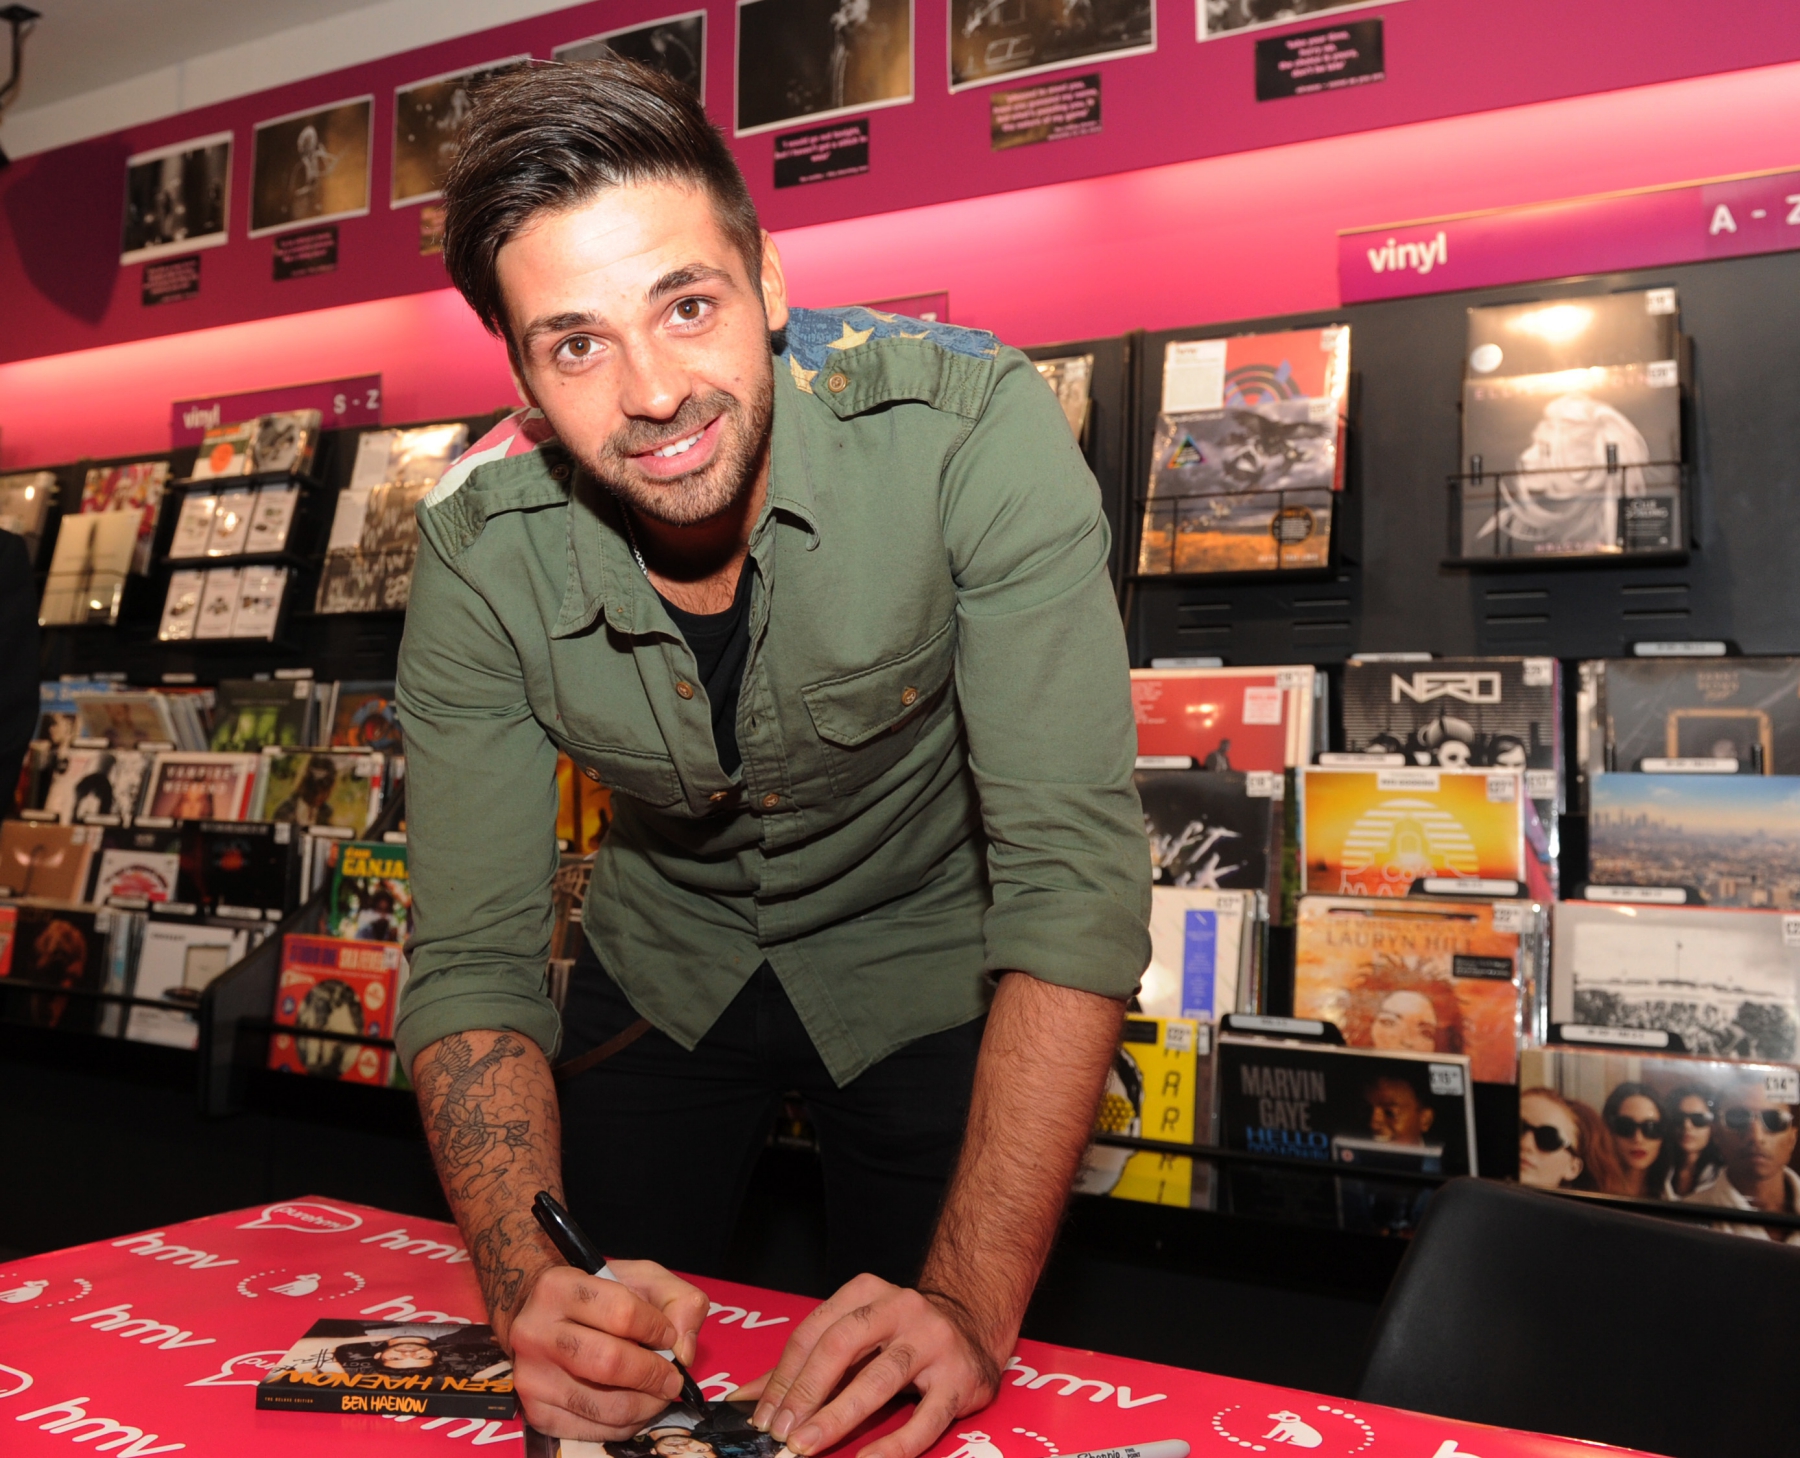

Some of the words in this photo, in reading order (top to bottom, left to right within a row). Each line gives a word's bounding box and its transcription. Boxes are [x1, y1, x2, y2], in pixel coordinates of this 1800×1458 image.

[1709, 204, 1737, 235] A
[1367, 231, 1447, 275] vinyl
[182, 404, 220, 430] vinyl
[333, 392, 346, 414] S
[366, 388, 379, 410] Z
[1326, 930, 1416, 950] LAURYN
[1425, 935, 1471, 952] HILL
[1240, 1064, 1327, 1103] MARVIN
[1259, 1098, 1312, 1131] GAYE
[273, 1206, 348, 1230] purehmv
[111, 1231, 239, 1270] hmv
[70, 1303, 216, 1350] hmv
[1004, 1356, 1167, 1409] hmv
[341, 1395, 368, 1412] BEN
[370, 1395, 428, 1413] HAENOW
[15, 1396, 186, 1458] hmv
